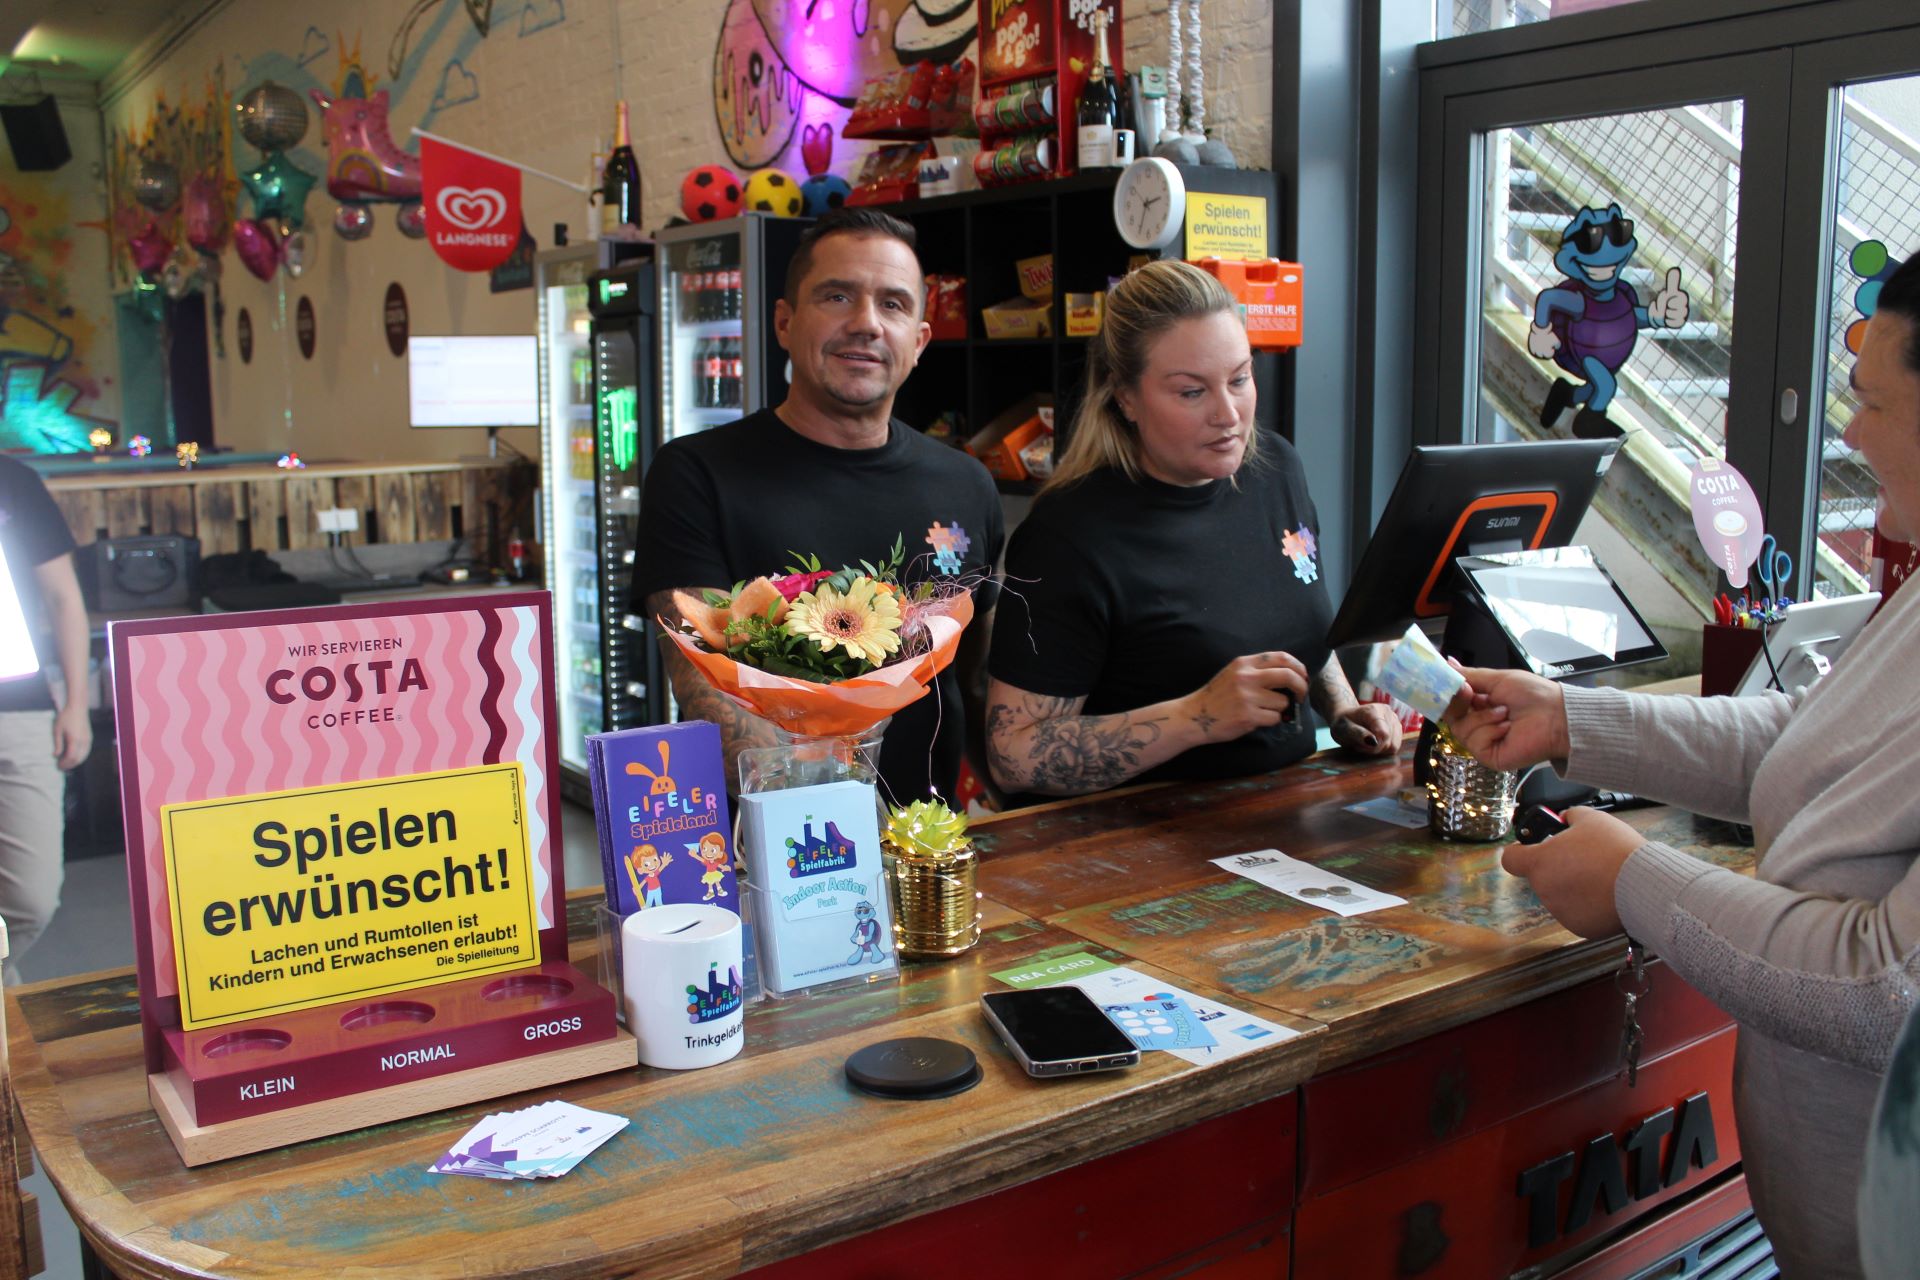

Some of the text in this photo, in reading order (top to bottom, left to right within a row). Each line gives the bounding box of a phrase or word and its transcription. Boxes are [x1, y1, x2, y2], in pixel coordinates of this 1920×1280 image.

[996, 11, 1028, 56] pop
[1014, 23, 1040, 69] go!
[1204, 202, 1250, 220] Spielen
[437, 232, 508, 247] LANGNESE
[1193, 221, 1262, 238] erwünscht!
[1248, 304, 1297, 315] ERSTE HILFE
[1697, 474, 1740, 495] COSTA
[1712, 496, 1738, 506] COFFEE
[288, 637, 403, 657] WIR SERVIEREN
[265, 657, 429, 705] COSTA
[307, 707, 395, 729] COFFEE
[628, 787, 717, 823] EIFELER
[631, 810, 718, 841] Spieleland
[253, 807, 458, 875] Spielen
[798, 843, 847, 863] EIFELER
[800, 856, 846, 872] Spielfabrik
[203, 848, 510, 936] erwünscht!
[783, 877, 868, 910] Indoor Action
[817, 896, 838, 908] Park
[250, 912, 480, 965] Lachen und Rumtollen ist
[209, 924, 518, 992] Kindern und Erwachsenen erlaubt!
[436, 943, 520, 967] Die Spielleitung
[1008, 957, 1095, 985] REA CARD
[523, 1016, 582, 1041] GROSS
[380, 1043, 456, 1071] NORMAL
[239, 1076, 296, 1101] KLEIN
[1517, 1090, 1719, 1249] TATA
